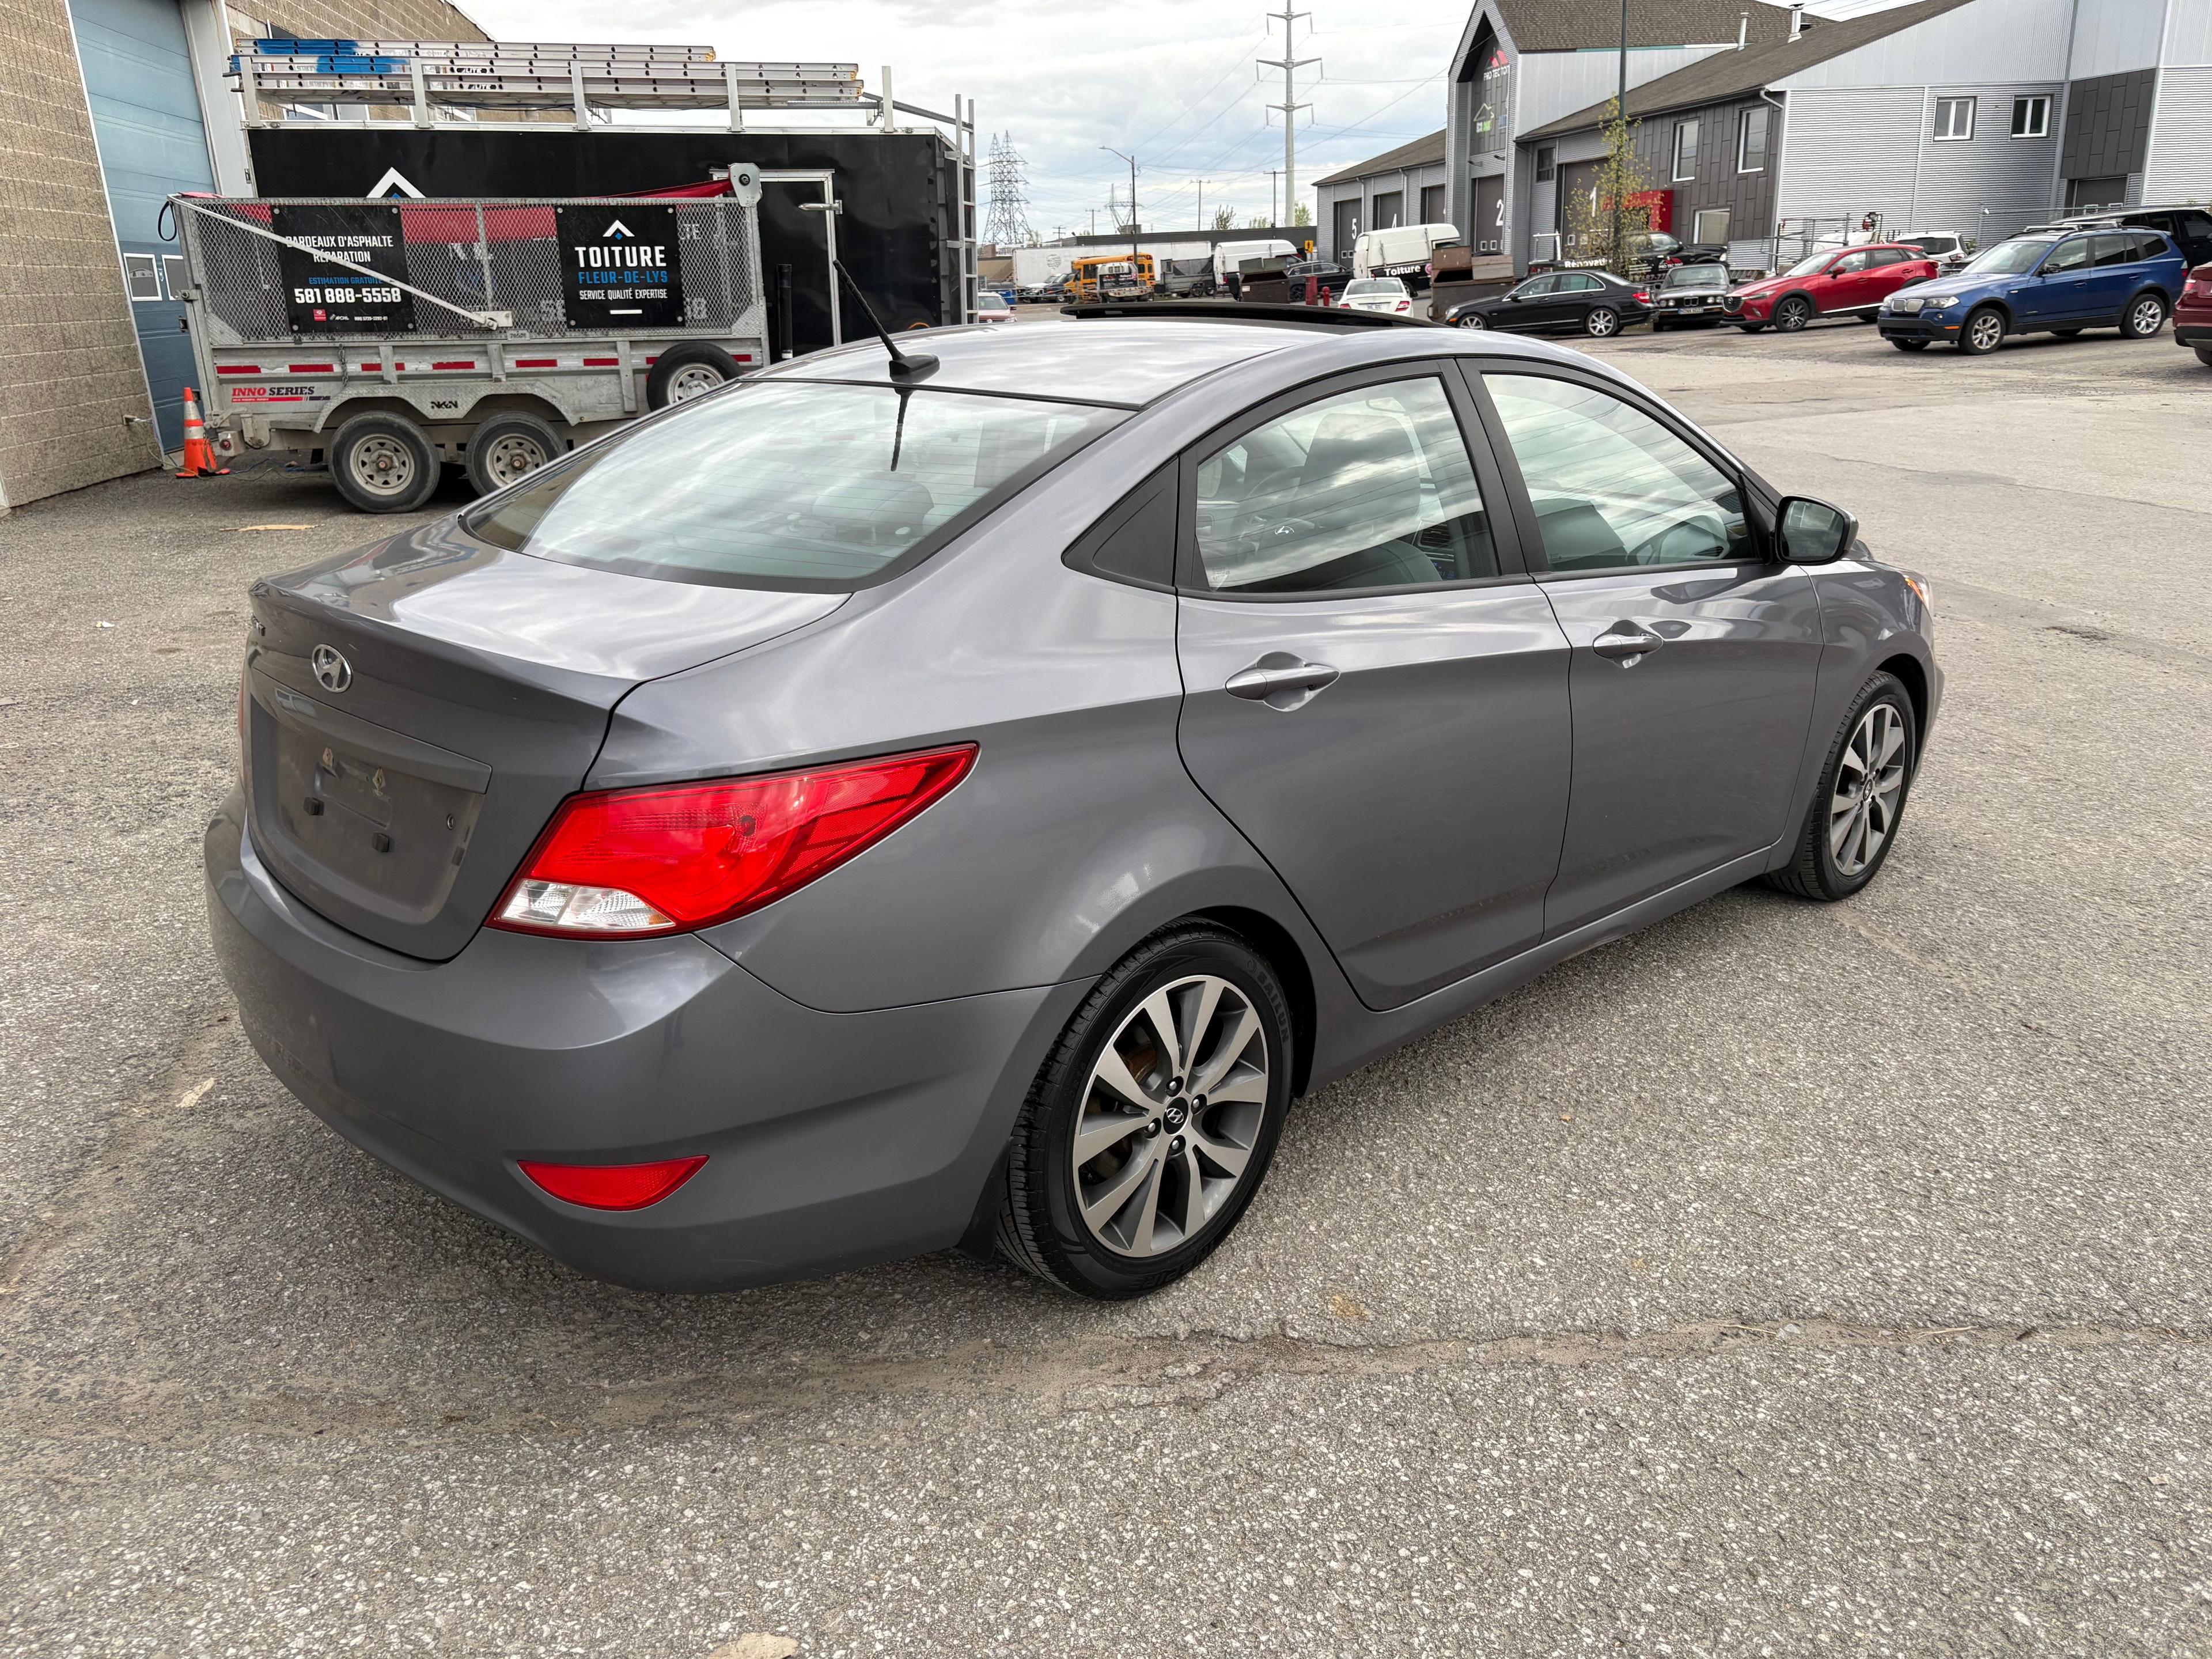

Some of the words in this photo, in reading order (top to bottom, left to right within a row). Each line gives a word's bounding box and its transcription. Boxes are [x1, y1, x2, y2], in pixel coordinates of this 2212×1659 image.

[1495, 199, 1504, 226] 2
[1351, 218, 1358, 240] 5
[338, 236, 394, 247] D'ASPHALTE
[574, 245, 667, 268] TOITURE
[308, 276, 350, 285] ESTIMATION
[578, 270, 669, 284] FLEUR-DE-LYS
[294, 288, 322, 304] 581
[324, 287, 402, 304] 888-5558
[579, 290, 605, 300] SERVICE
[608, 288, 633, 300] QUALITÉ
[635, 289, 668, 300] EXPERTISE
[232, 387, 267, 397] INNO
[269, 386, 315, 396] SERIES
[1257, 971, 1290, 1043] SAILUN
